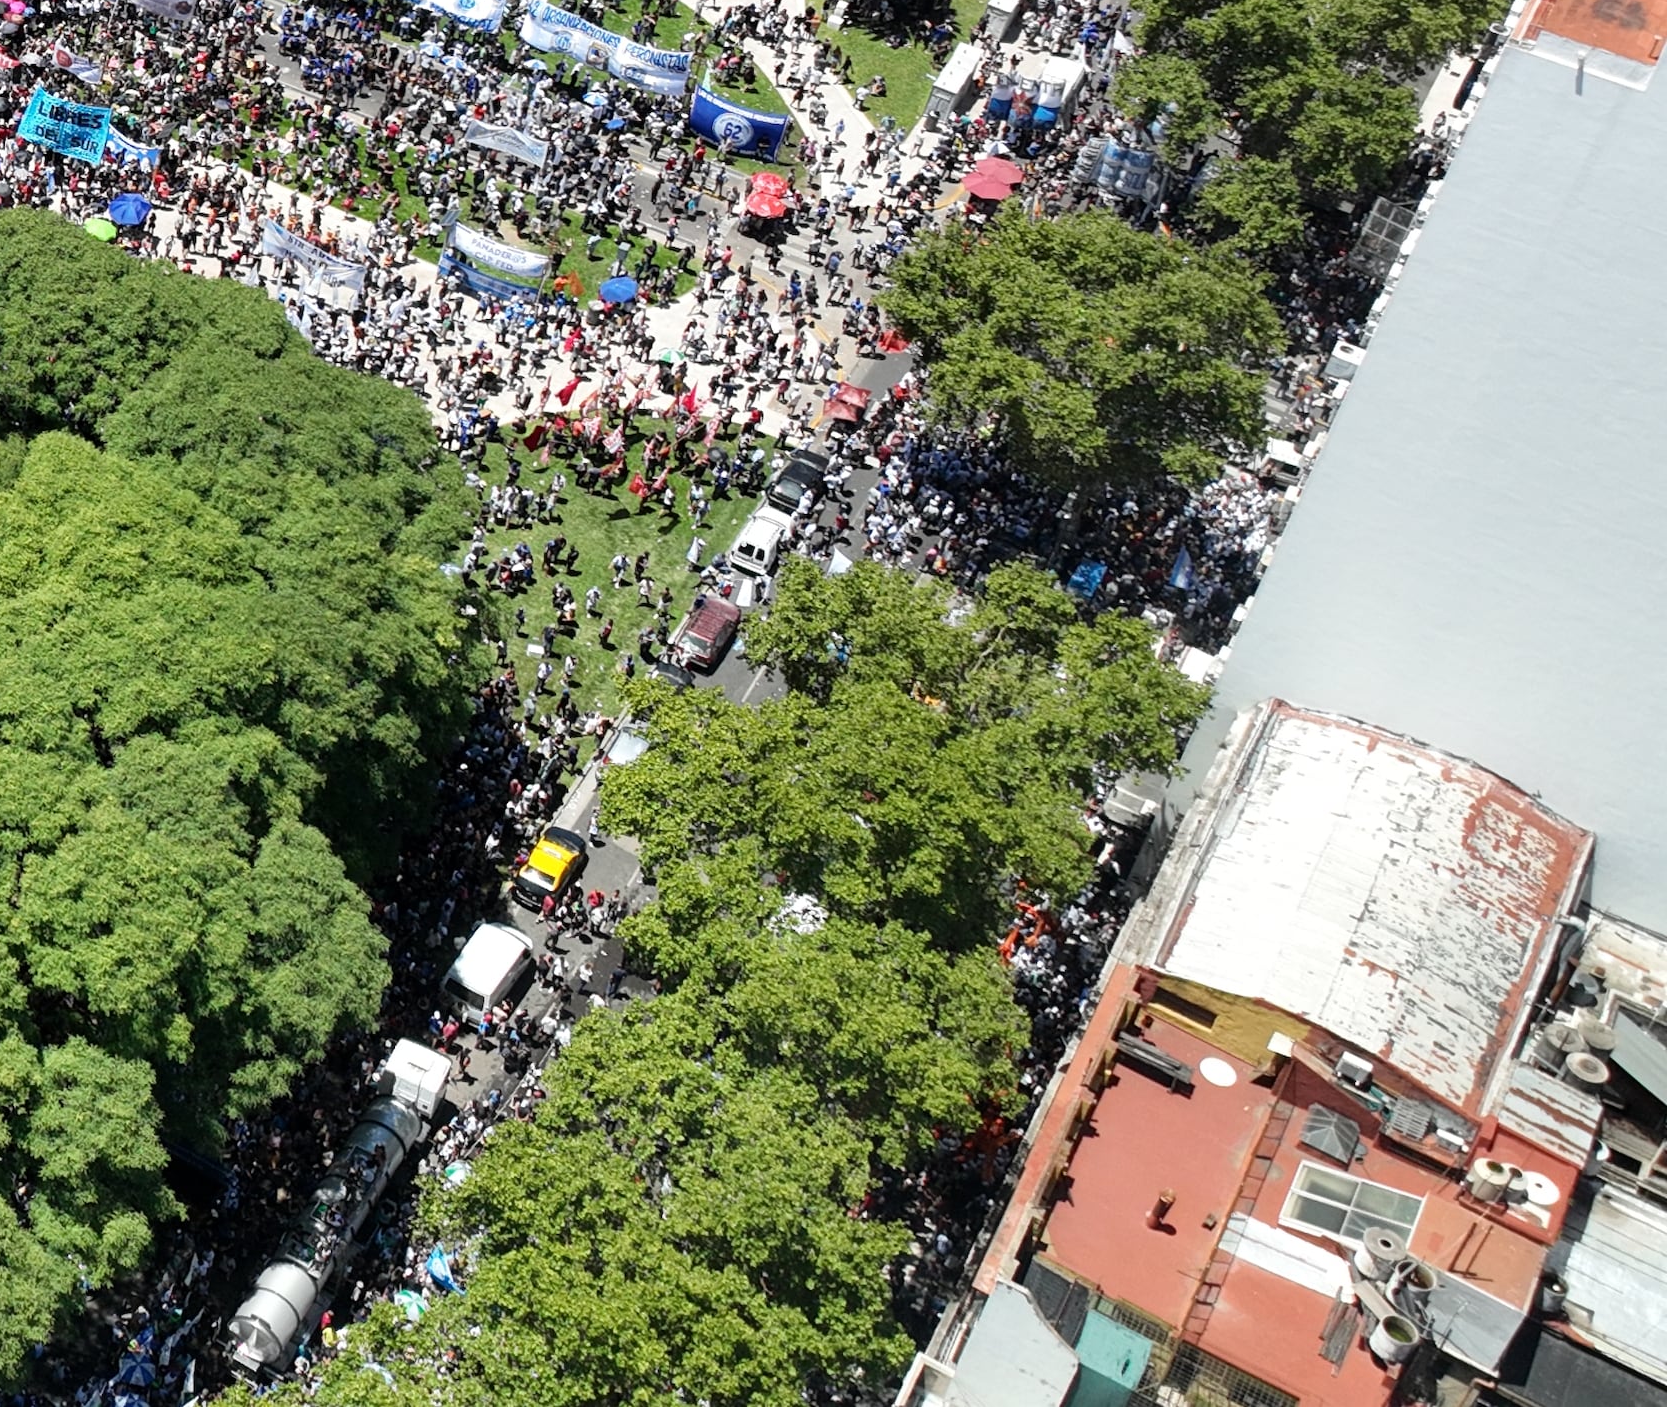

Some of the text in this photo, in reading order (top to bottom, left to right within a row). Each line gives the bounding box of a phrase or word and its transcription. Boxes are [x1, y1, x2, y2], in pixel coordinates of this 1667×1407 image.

[541, 6, 621, 47] ORGANIZACIONES
[625, 40, 689, 73] PERONISTAS
[38, 101, 104, 130] LIBRES
[723, 122, 742, 140] 62
